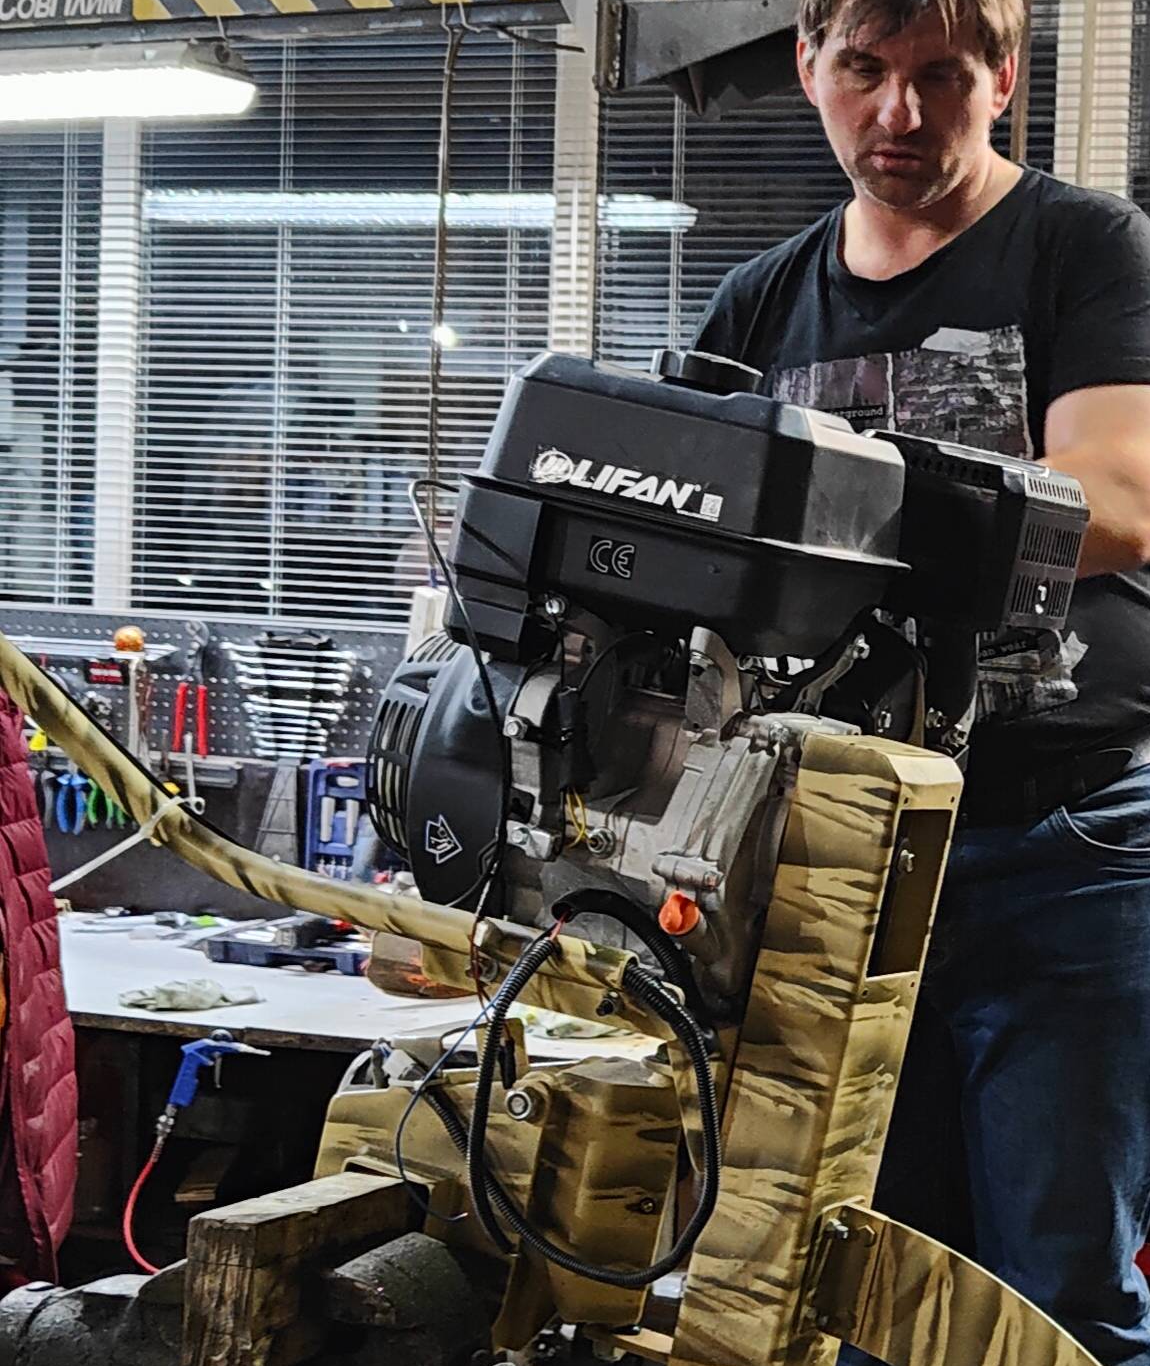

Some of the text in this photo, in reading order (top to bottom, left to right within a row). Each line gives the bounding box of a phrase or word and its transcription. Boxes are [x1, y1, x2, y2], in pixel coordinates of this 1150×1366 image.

[830, 406, 883, 419] erground
[569, 458, 696, 509] LIFAN
[590, 540, 635, 579] CE
